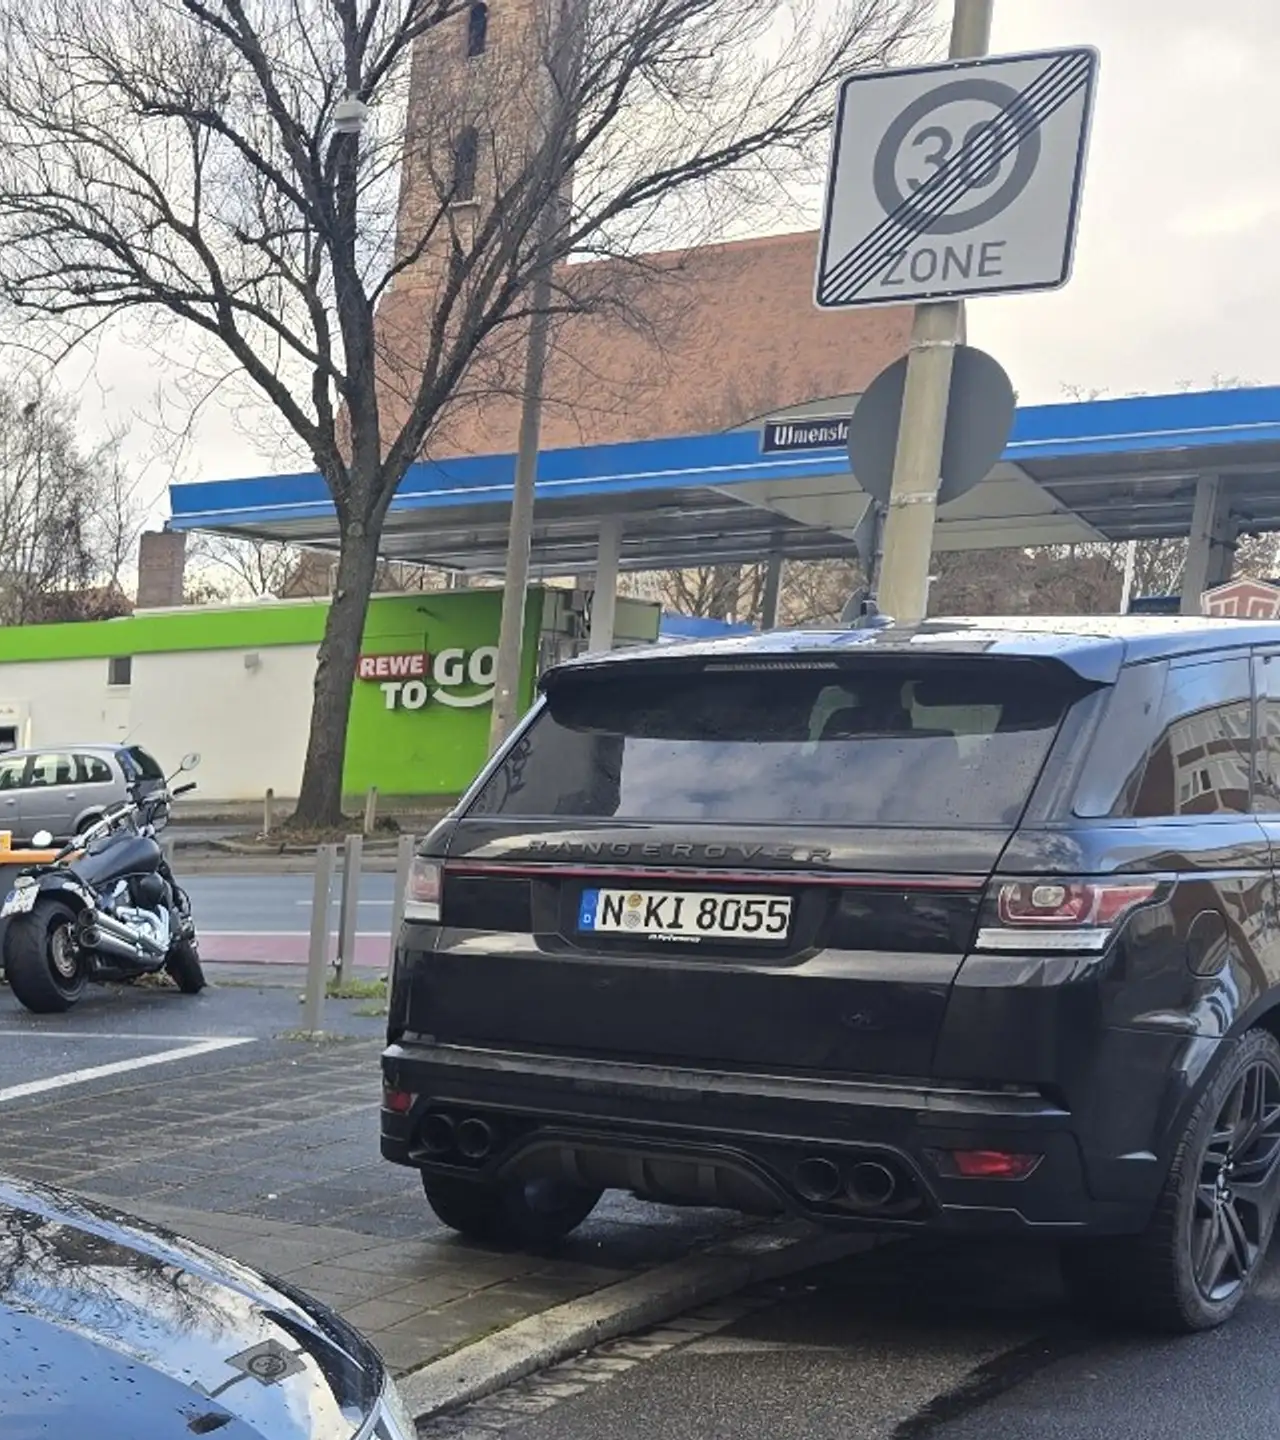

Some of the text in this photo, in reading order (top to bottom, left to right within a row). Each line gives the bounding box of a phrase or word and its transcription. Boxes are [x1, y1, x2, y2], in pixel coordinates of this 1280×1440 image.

[907, 120, 1003, 194] 30
[880, 241, 1007, 287] ZONE
[774, 422, 849, 446] Ulmenstr
[360, 654, 424, 677] REWE
[433, 646, 499, 686] GO
[380, 680, 428, 709] TO
[602, 894, 625, 927] N
[644, 896, 685, 929] KI
[696, 898, 789, 933] 8055
